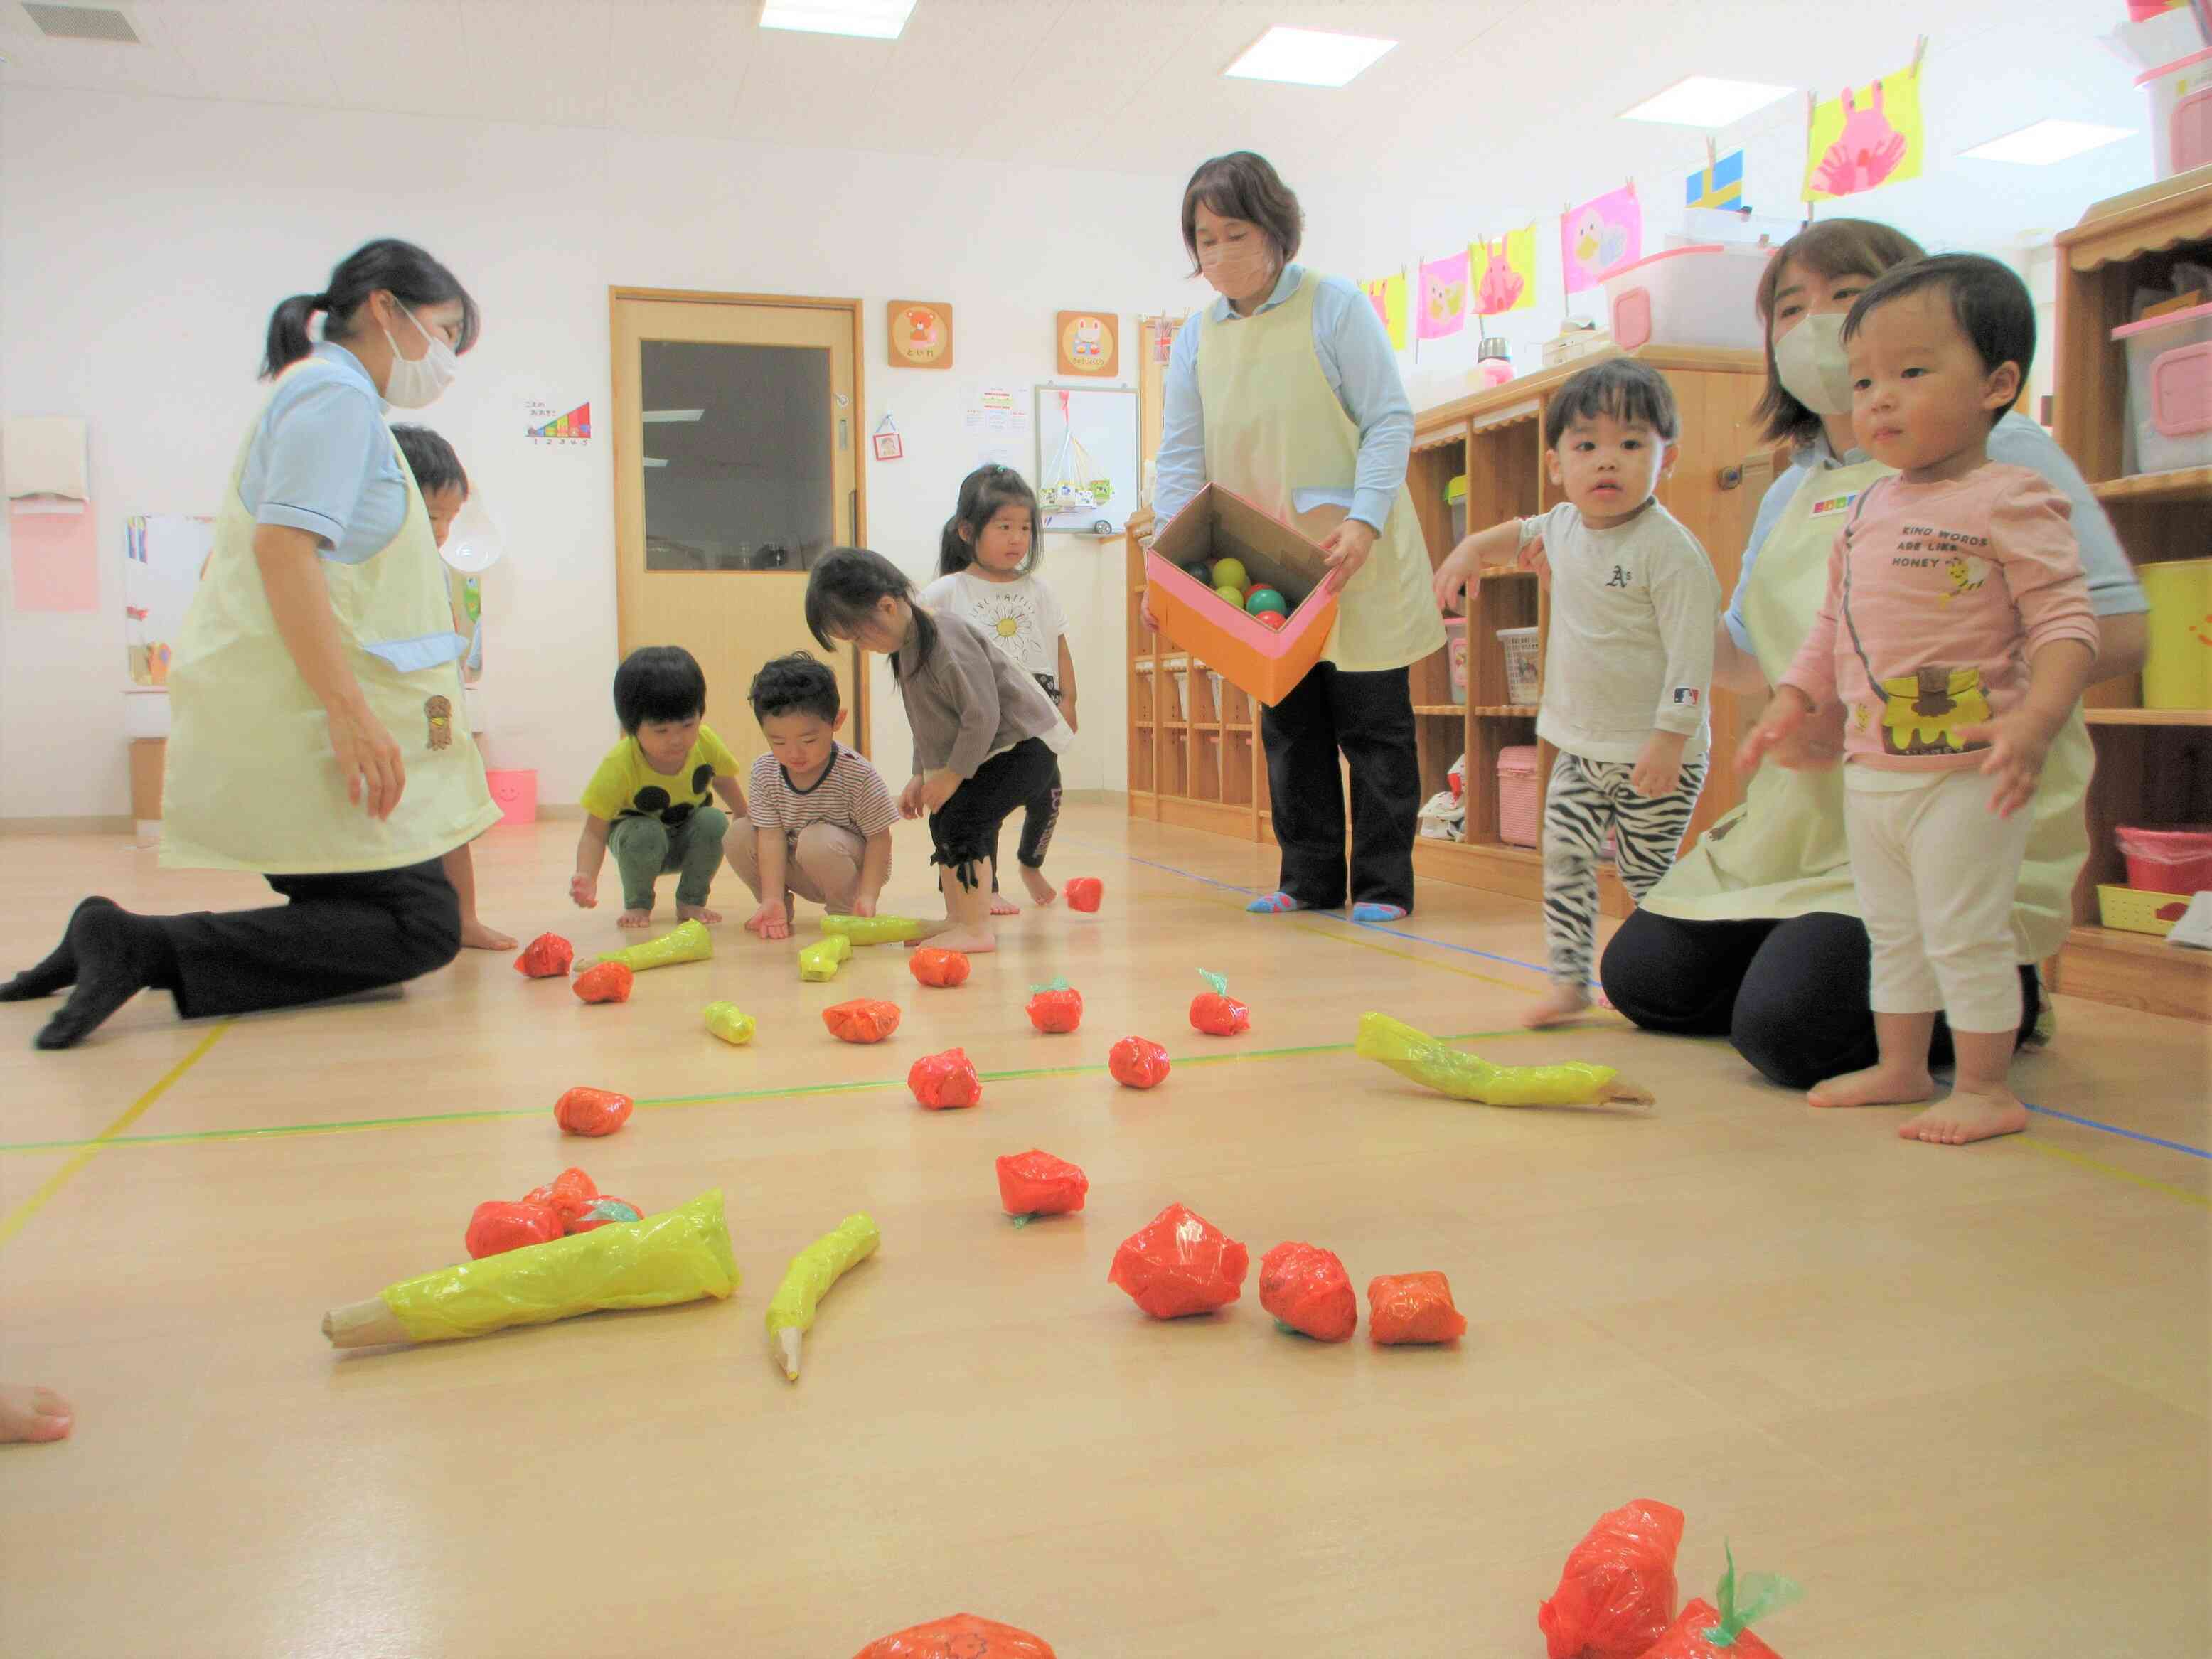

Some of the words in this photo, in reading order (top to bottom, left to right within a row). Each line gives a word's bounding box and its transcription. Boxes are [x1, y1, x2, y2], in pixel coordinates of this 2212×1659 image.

[1903, 526, 1933, 536] KIND
[1938, 530, 1989, 547] WORDS
[1897, 541, 1922, 551] ARE
[1928, 543, 1957, 552] LIKE
[1892, 557, 1940, 567] HONEY
